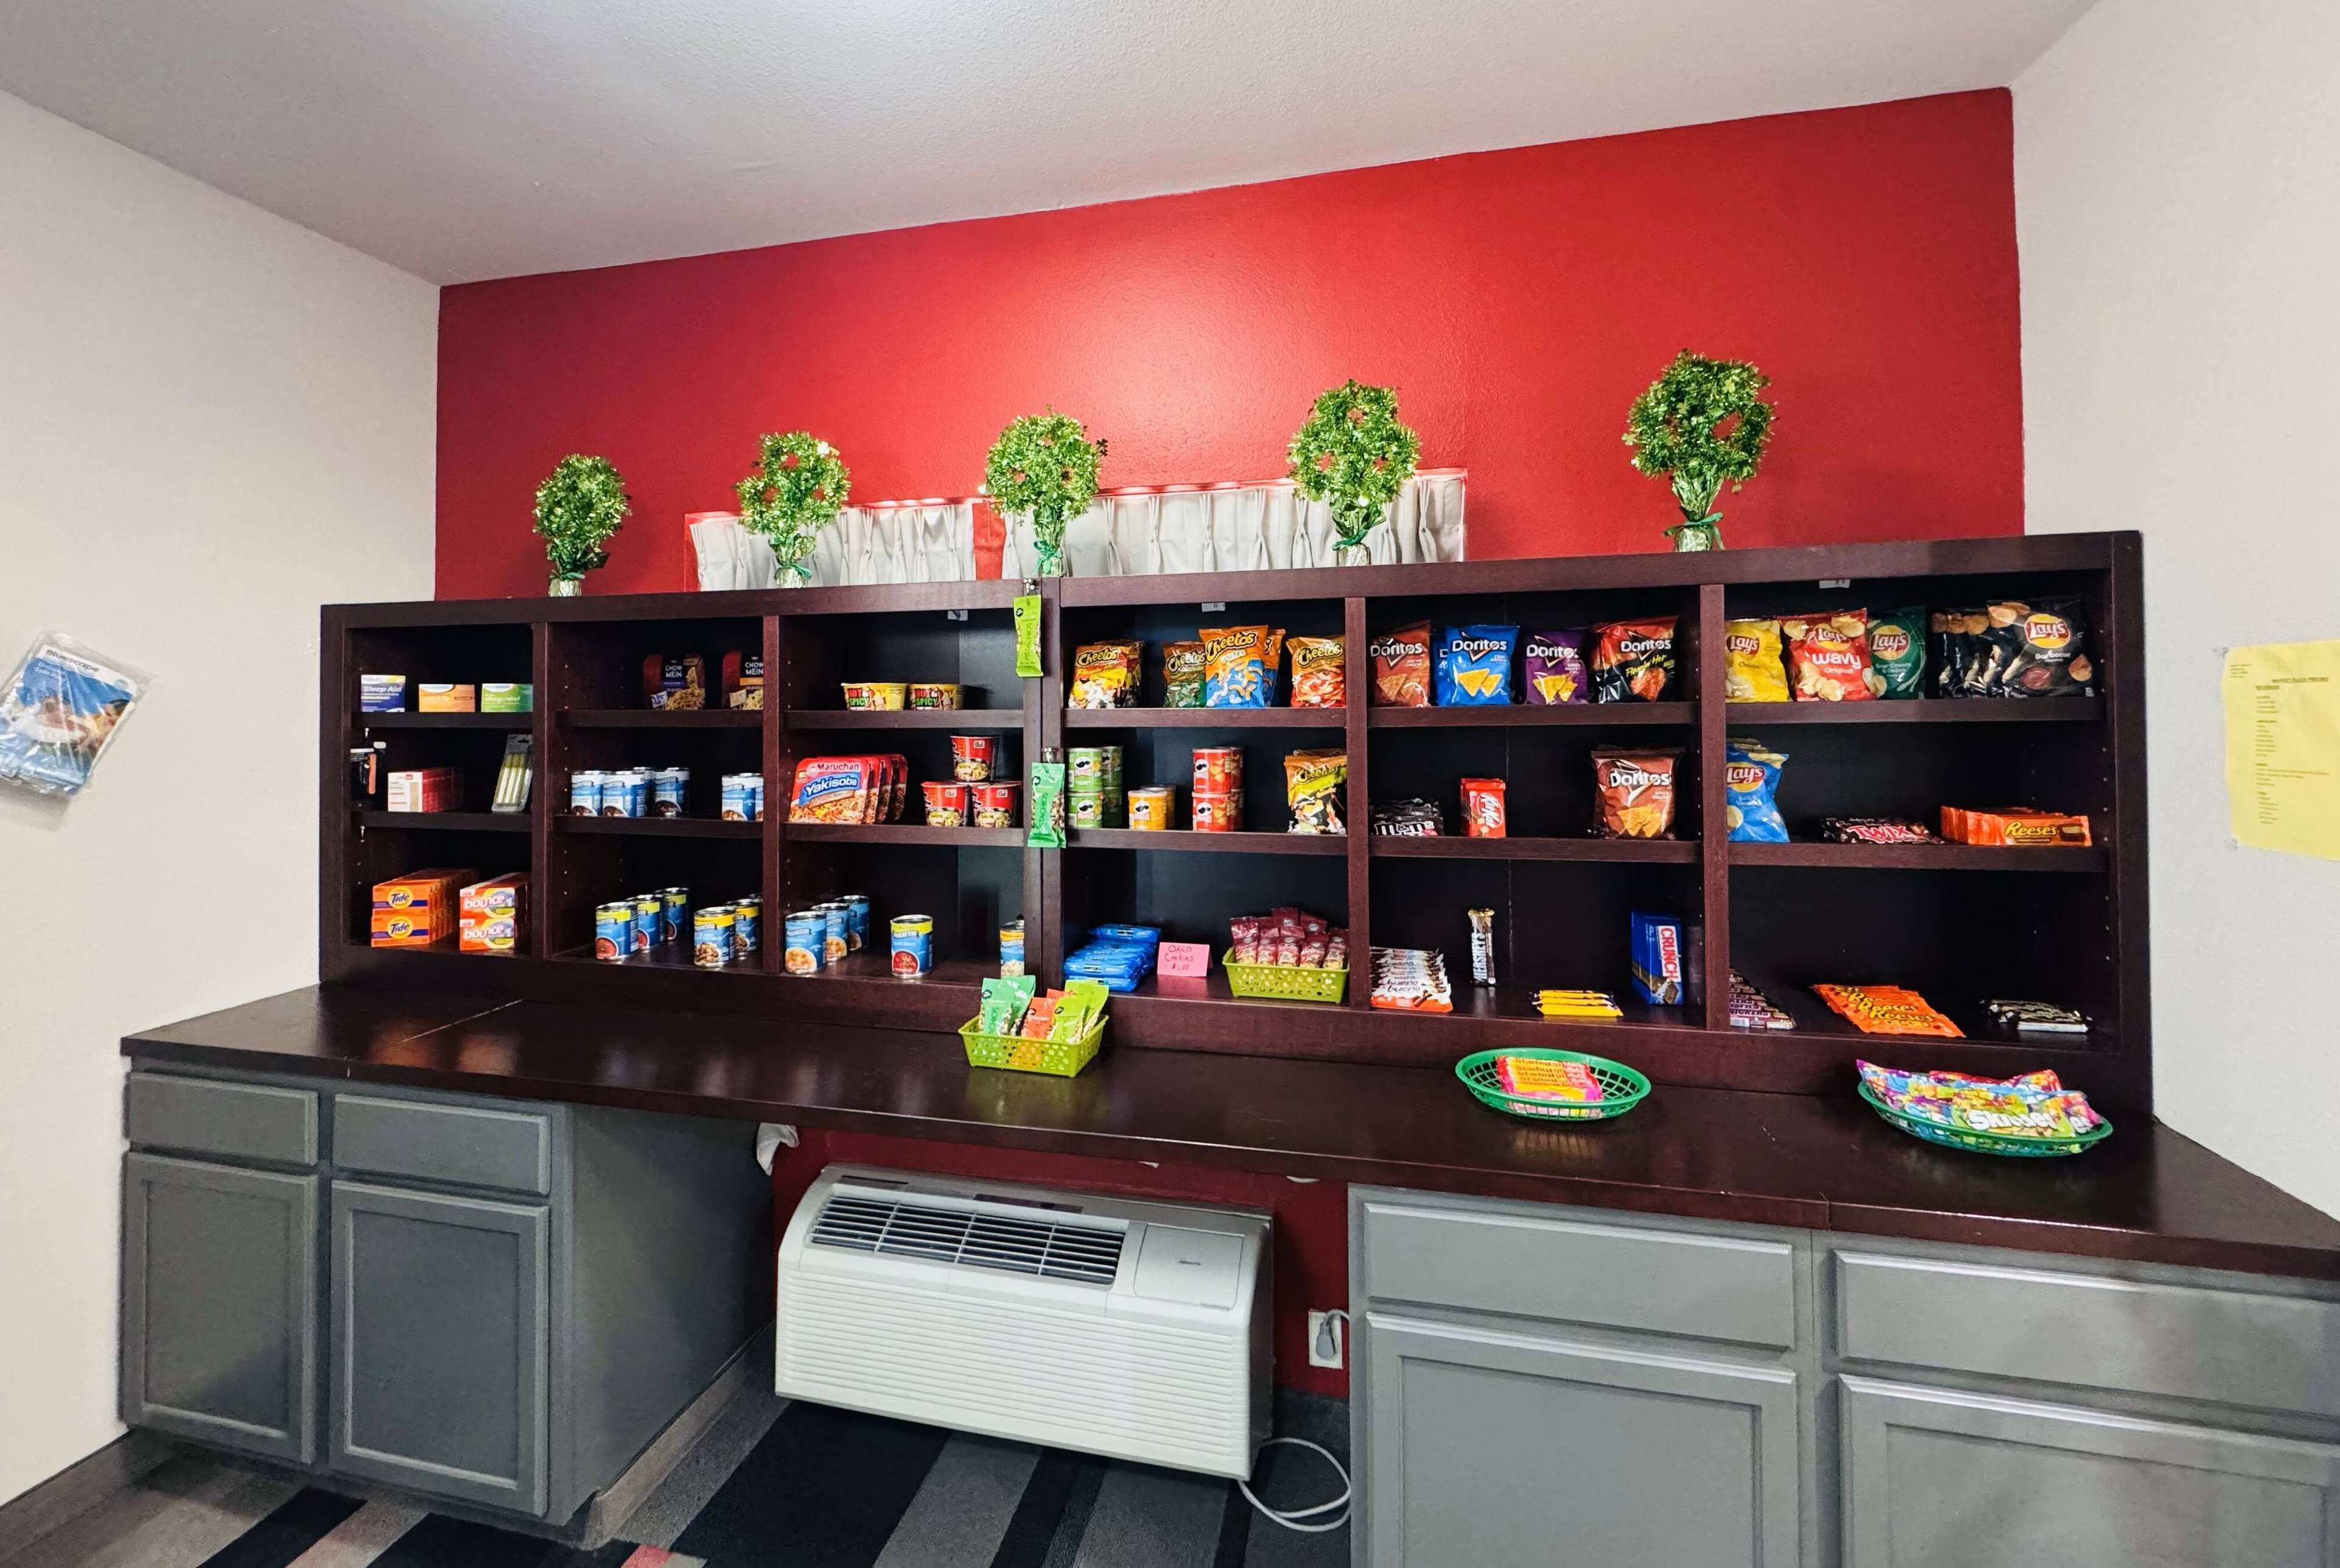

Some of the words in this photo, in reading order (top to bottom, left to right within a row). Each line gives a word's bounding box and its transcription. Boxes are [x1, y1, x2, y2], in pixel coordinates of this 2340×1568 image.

[1206, 632, 1256, 662] Cheetos
[1370, 643, 1423, 657] Doritos
[1452, 640, 1507, 651] Doritos
[1621, 639, 1671, 652] Doritos
[1077, 647, 1118, 666] Cheetos
[1168, 650, 1206, 673] Cheetos
[1298, 643, 1342, 665] Cheetos
[1812, 653, 1862, 669] wavy
[849, 697, 869, 706] SPICY
[805, 776, 858, 797] Yakisoba
[1610, 772, 1670, 787] Doritos
[1039, 792, 1048, 828] STACHIOS
[2005, 821, 2058, 836] Reese's
[391, 892, 410, 905] Tide
[463, 894, 505, 910] bounce
[390, 921, 410, 935] Tide
[463, 924, 505, 940] bounce
[1660, 928, 1679, 979] CRUNCH
